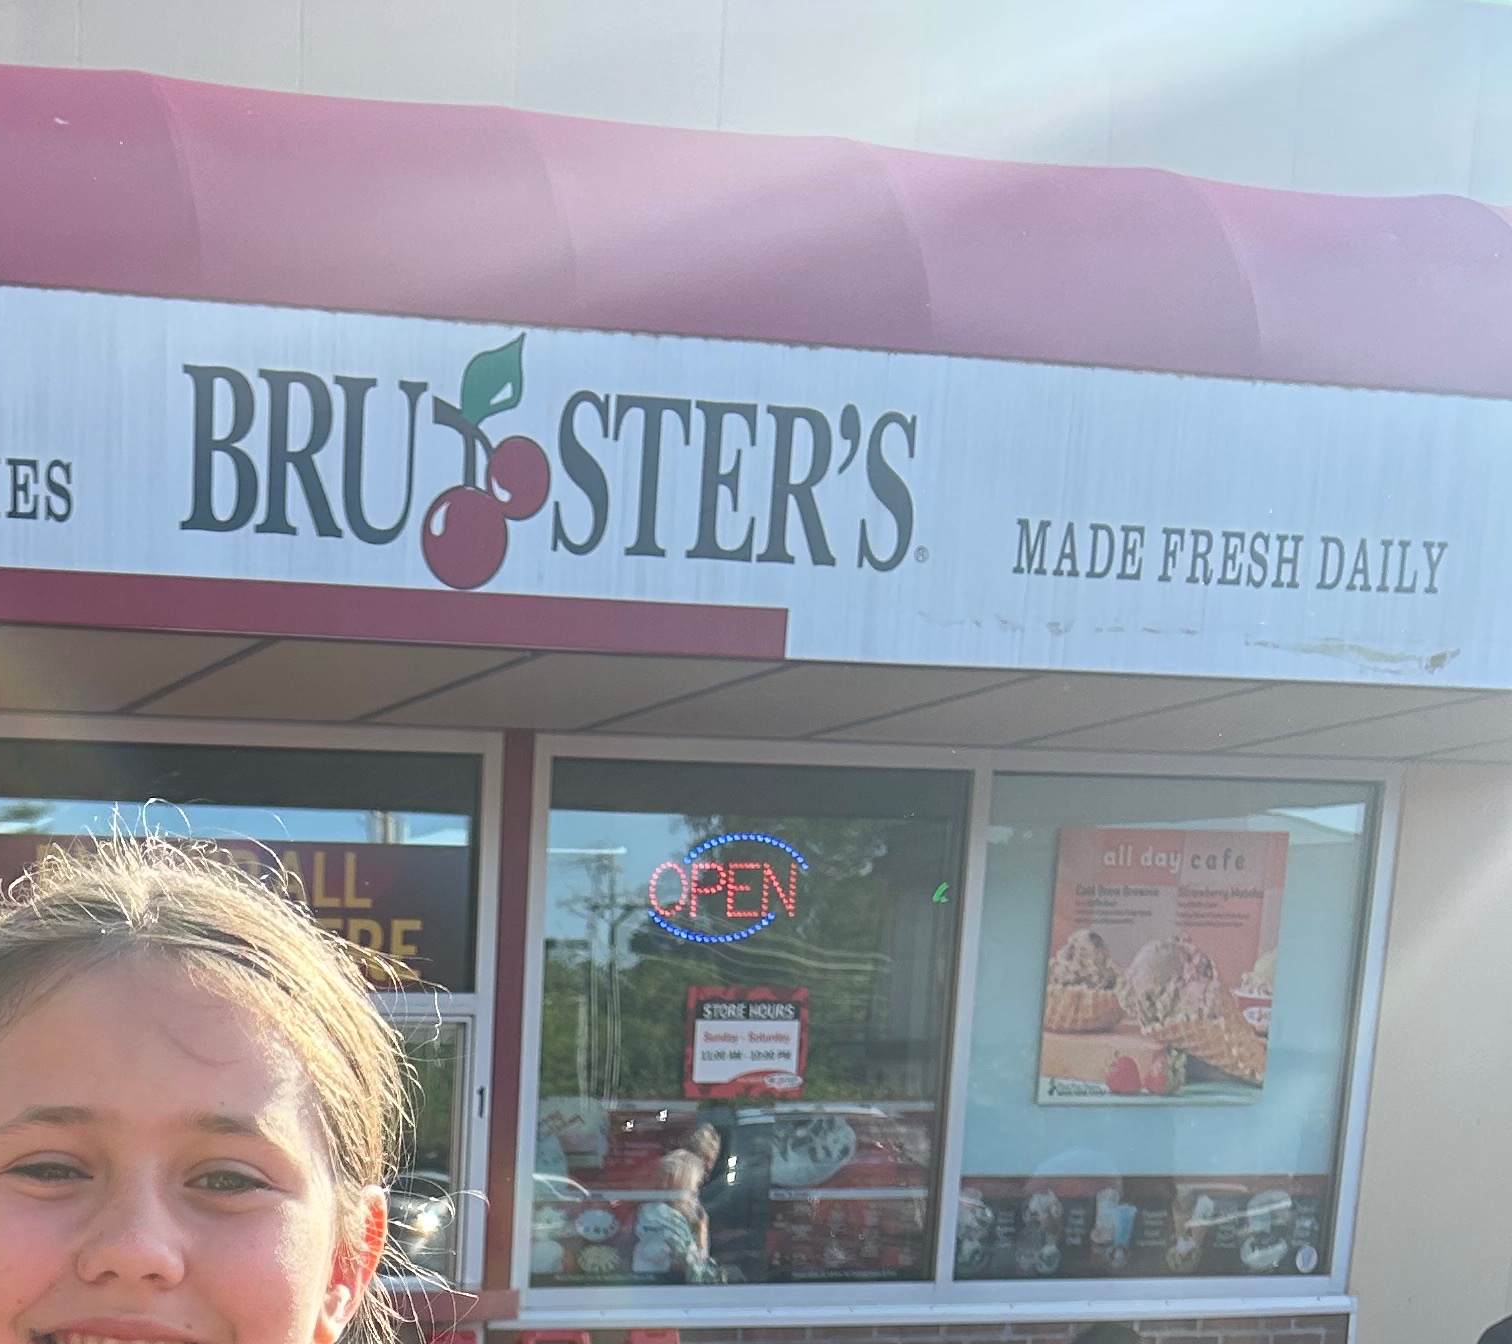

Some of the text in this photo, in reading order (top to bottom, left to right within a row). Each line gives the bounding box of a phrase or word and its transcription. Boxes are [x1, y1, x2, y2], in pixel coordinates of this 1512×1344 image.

[1012, 518, 1449, 594] MADE FRESH DAILY
[1103, 845, 1245, 874] all day cafe
[649, 861, 798, 918] OPEN
[703, 1003, 795, 1019] STORE HOURS
